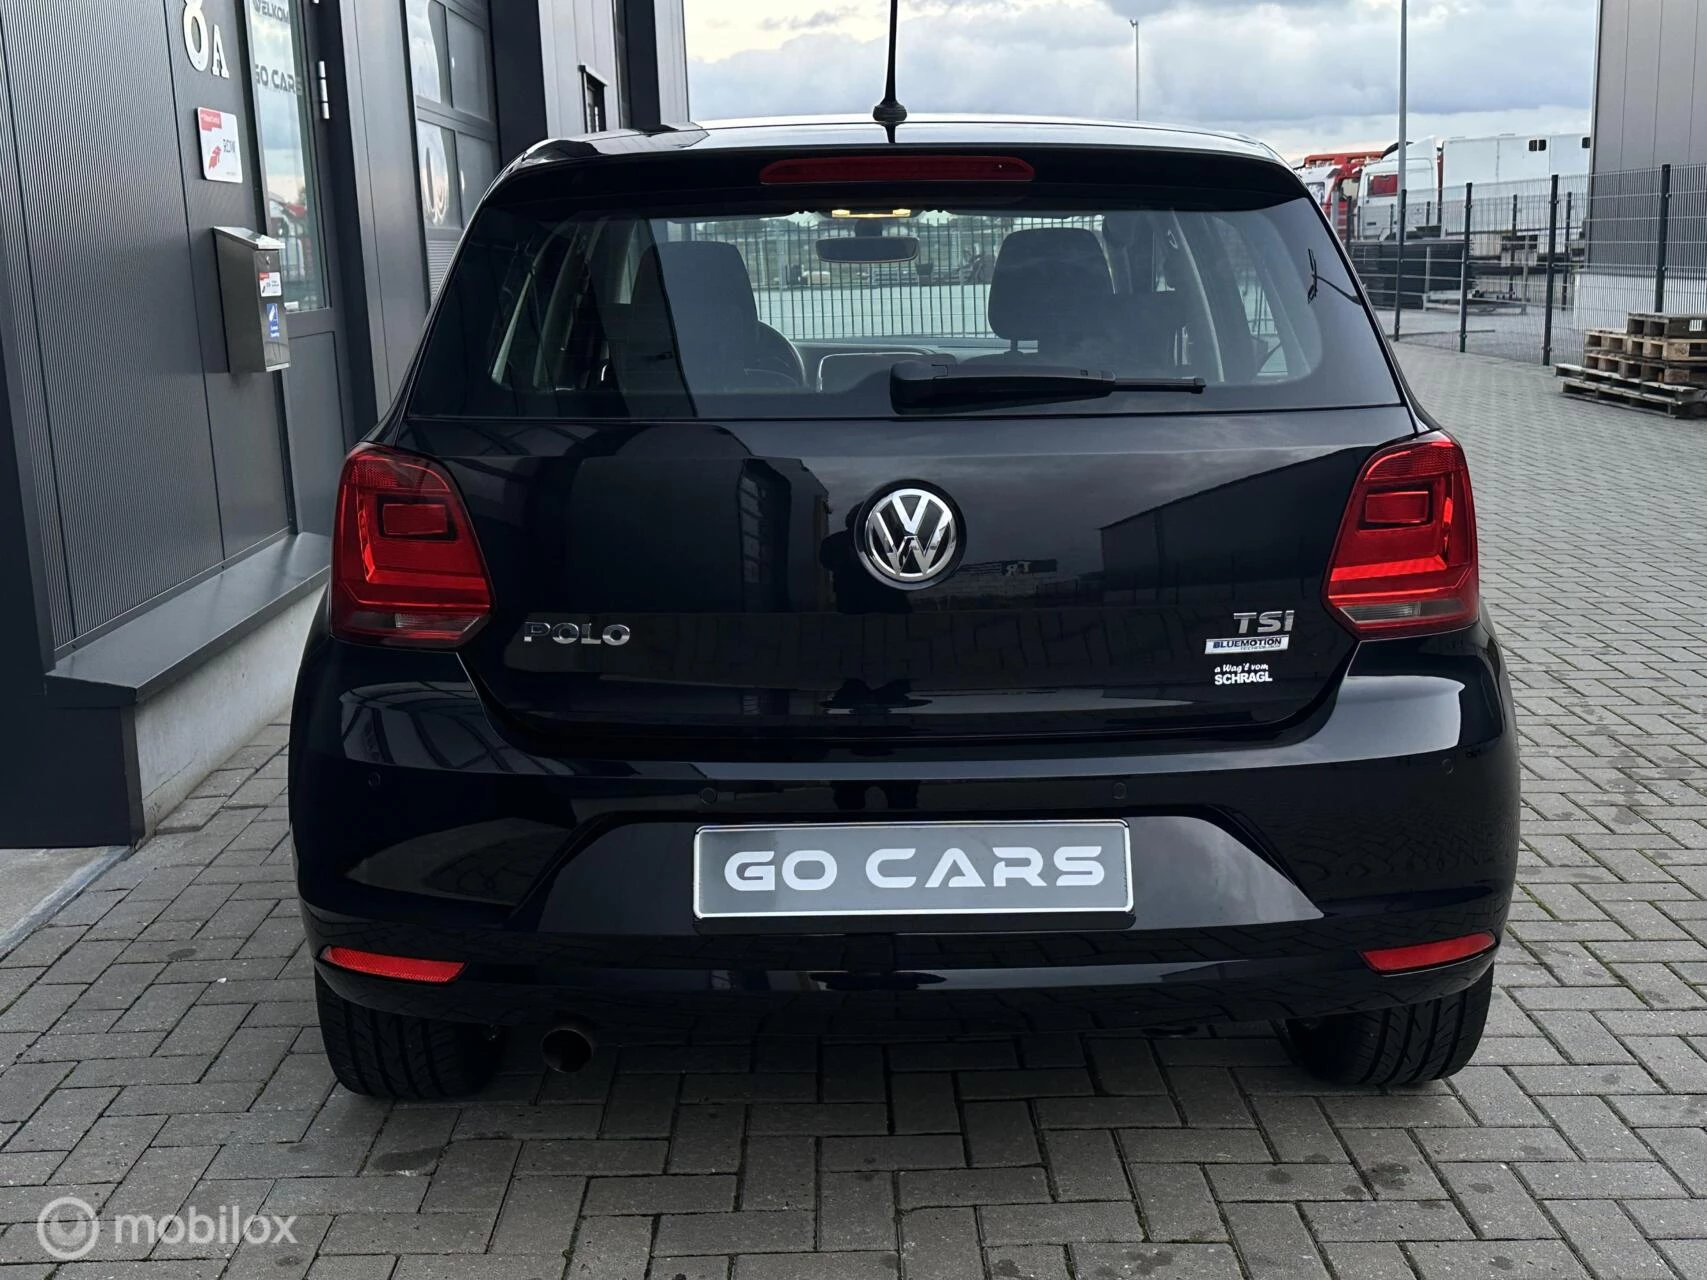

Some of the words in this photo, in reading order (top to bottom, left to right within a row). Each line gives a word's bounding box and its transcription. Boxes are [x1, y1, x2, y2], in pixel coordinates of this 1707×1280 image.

[1233, 610, 1295, 634] TSI
[524, 621, 631, 646] POLO
[1213, 637, 1282, 649] BLUEMOTION
[1251, 663, 1269, 671] vom
[1214, 671, 1273, 685] SCHRAGL
[724, 850, 838, 891] GO
[865, 846, 1105, 888] CARS
